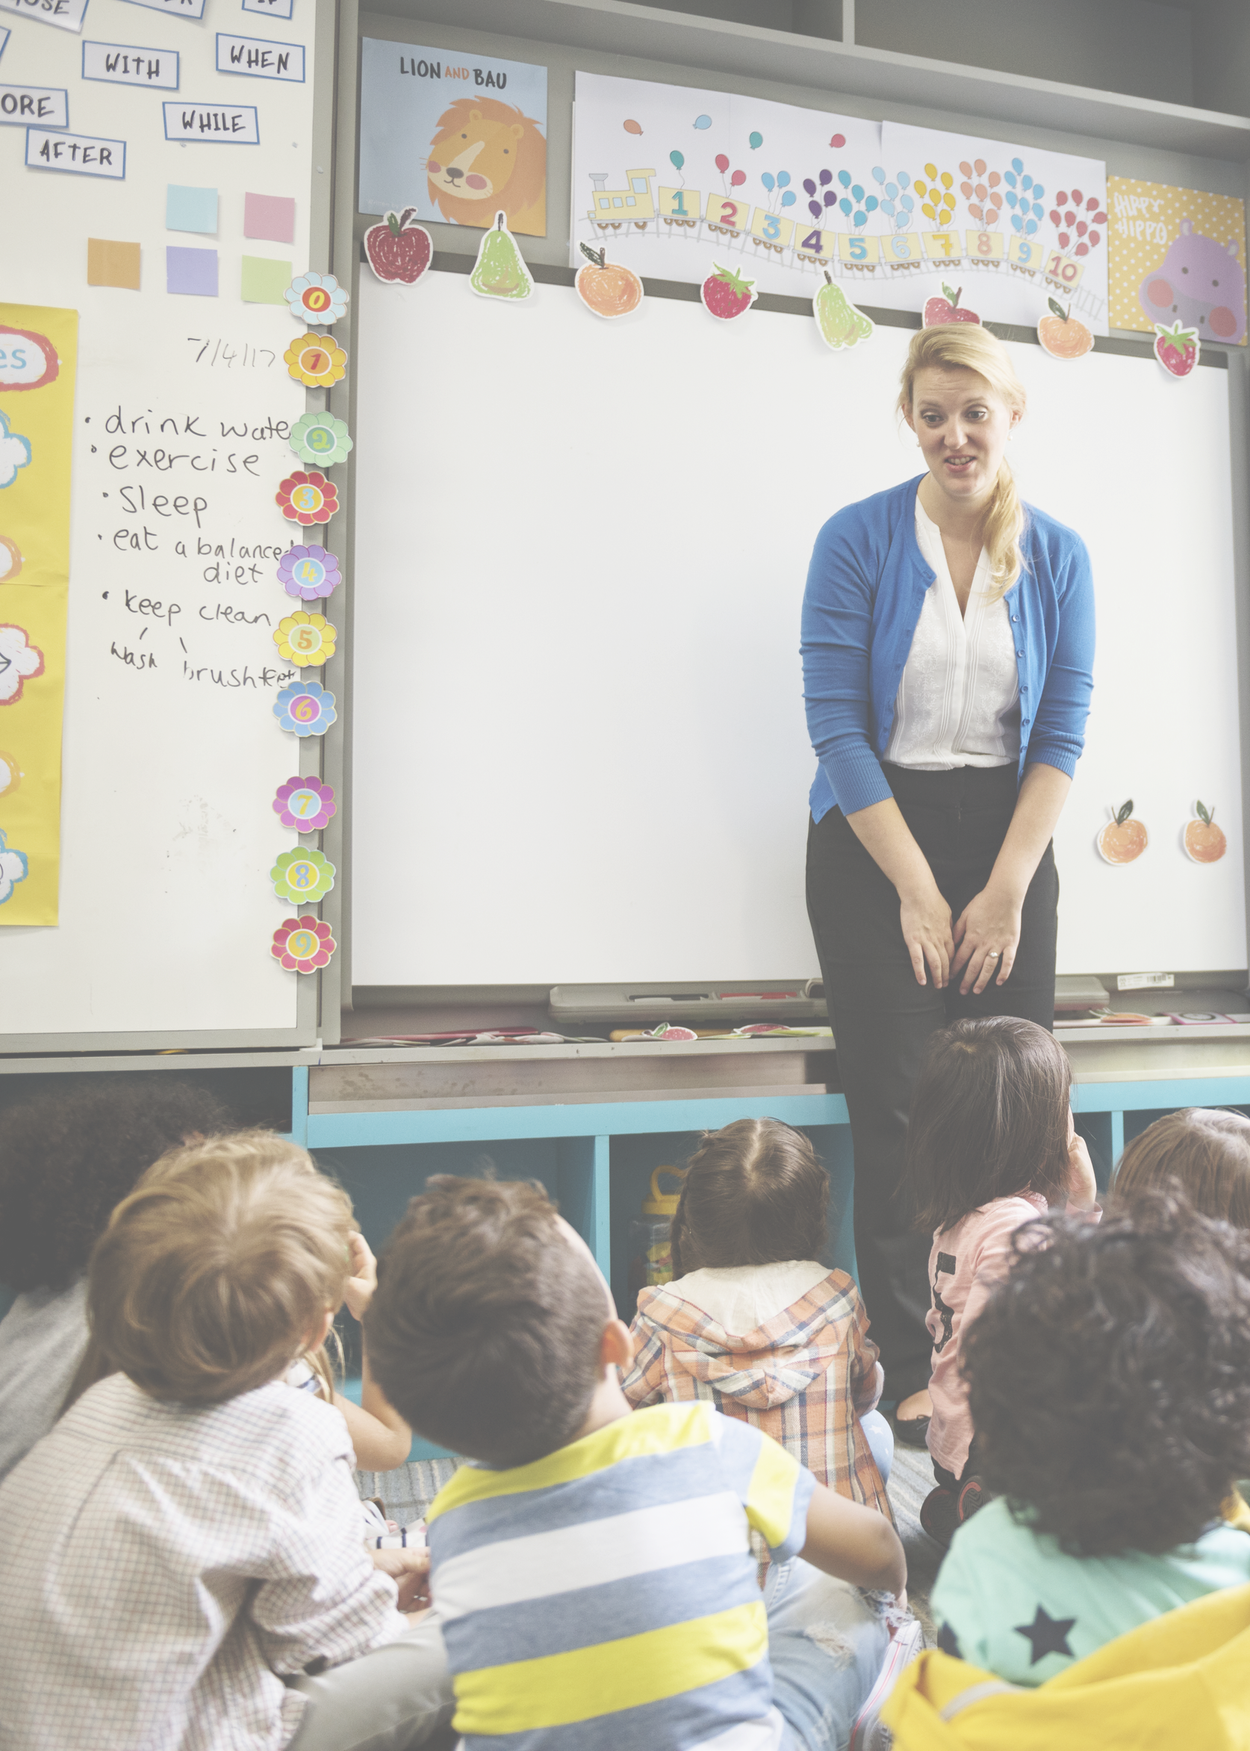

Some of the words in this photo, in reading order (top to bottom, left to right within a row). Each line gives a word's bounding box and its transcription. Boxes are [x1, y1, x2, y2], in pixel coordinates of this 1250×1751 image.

[105, 53, 161, 80] WITH
[230, 45, 290, 75] WHEN
[400, 56, 442, 80] LION
[444, 65, 471, 81] AND
[473, 67, 508, 90] BAU
[182, 110, 247, 134] WHILE
[39, 139, 113, 166] AFTER
[671, 190, 689, 217] 1
[720, 201, 738, 227] 2
[761, 213, 782, 240] 3
[800, 230, 824, 254] 4
[848, 237, 868, 261] 5
[891, 235, 911, 260] 6
[931, 233, 954, 257] 7
[976, 232, 993, 256] 8
[1017, 240, 1032, 264] 9
[1049, 254, 1078, 281] 10
[1118, 218, 1167, 245] HIPPO
[308, 291, 325, 309] 0
[309, 352, 322, 371] 1
[105, 405, 207, 437] drink
[220, 415, 291, 441] wate
[311, 430, 330, 449] 2
[108, 444, 261, 477] exercise
[300, 488, 315, 508] 3
[113, 526, 159, 551] eat
[174, 541, 188, 558] a
[197, 537, 294, 561] balance
[203, 561, 264, 585] diet
[300, 562, 318, 583] 4
[199, 603, 272, 627] clean
[297, 629, 313, 650] 5
[295, 698, 312, 720] 6
[296, 794, 313, 815] 7
[295, 863, 310, 888] 8
[295, 933, 312, 956] 9
